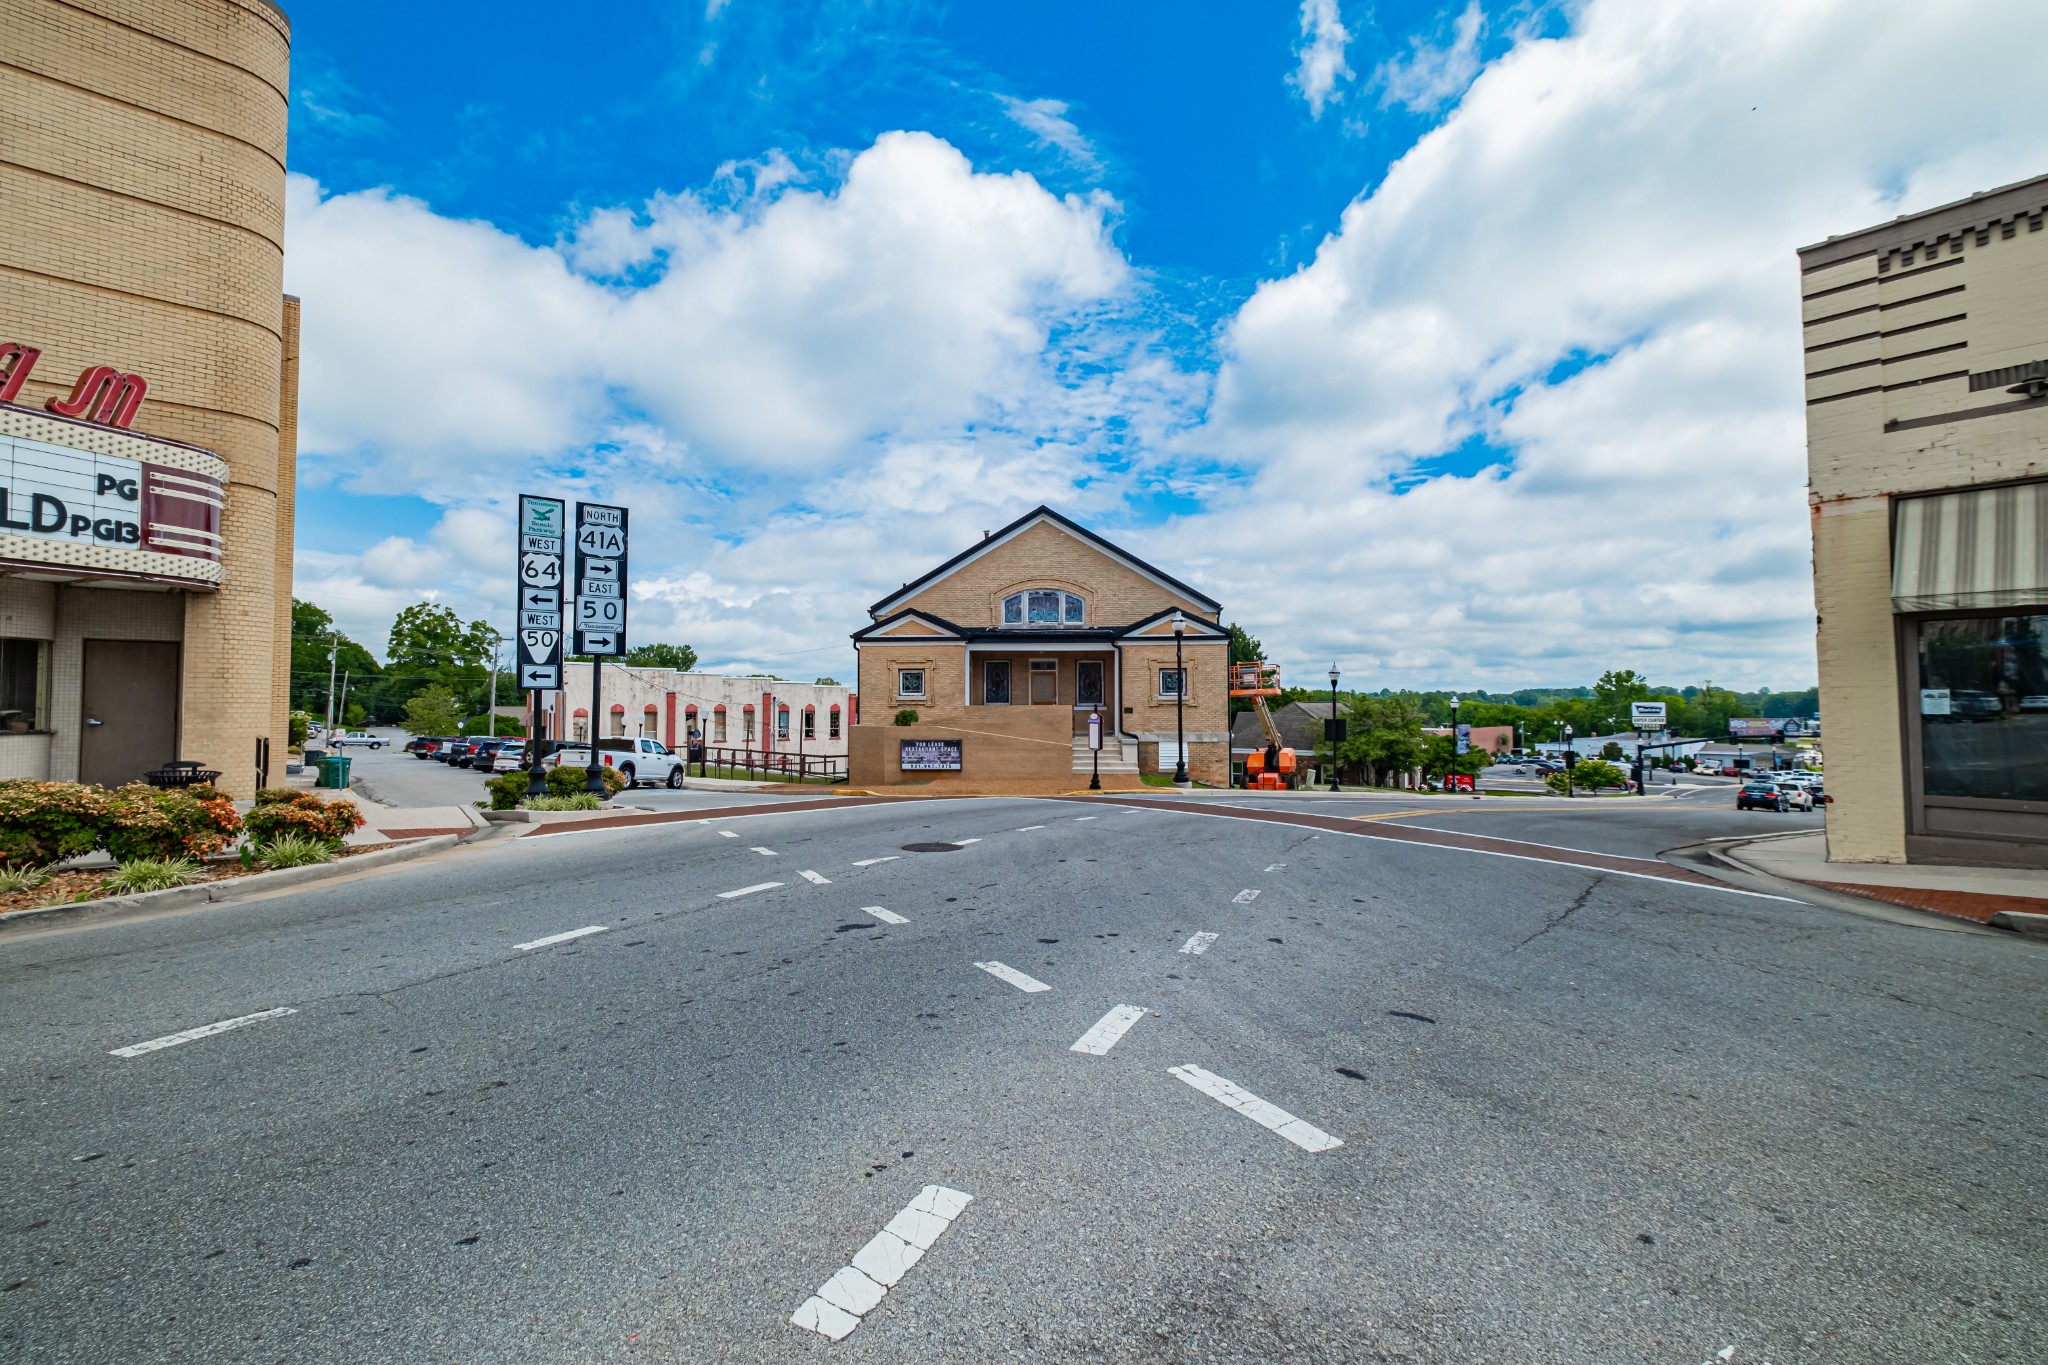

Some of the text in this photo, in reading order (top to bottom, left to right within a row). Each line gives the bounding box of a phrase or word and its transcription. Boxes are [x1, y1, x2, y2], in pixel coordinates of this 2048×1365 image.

[97, 473, 138, 501] PG
[531, 520, 554, 528] Scenic
[586, 510, 619, 523] NORTH
[71, 514, 140, 543] PG13
[528, 537, 556, 551] WEST
[581, 530, 621, 551] 41A
[524, 560, 557, 580] 64
[588, 582, 613, 594] EAST
[583, 600, 618, 620] 50
[527, 613, 555, 626] WEST
[527, 631, 554, 647] 50
